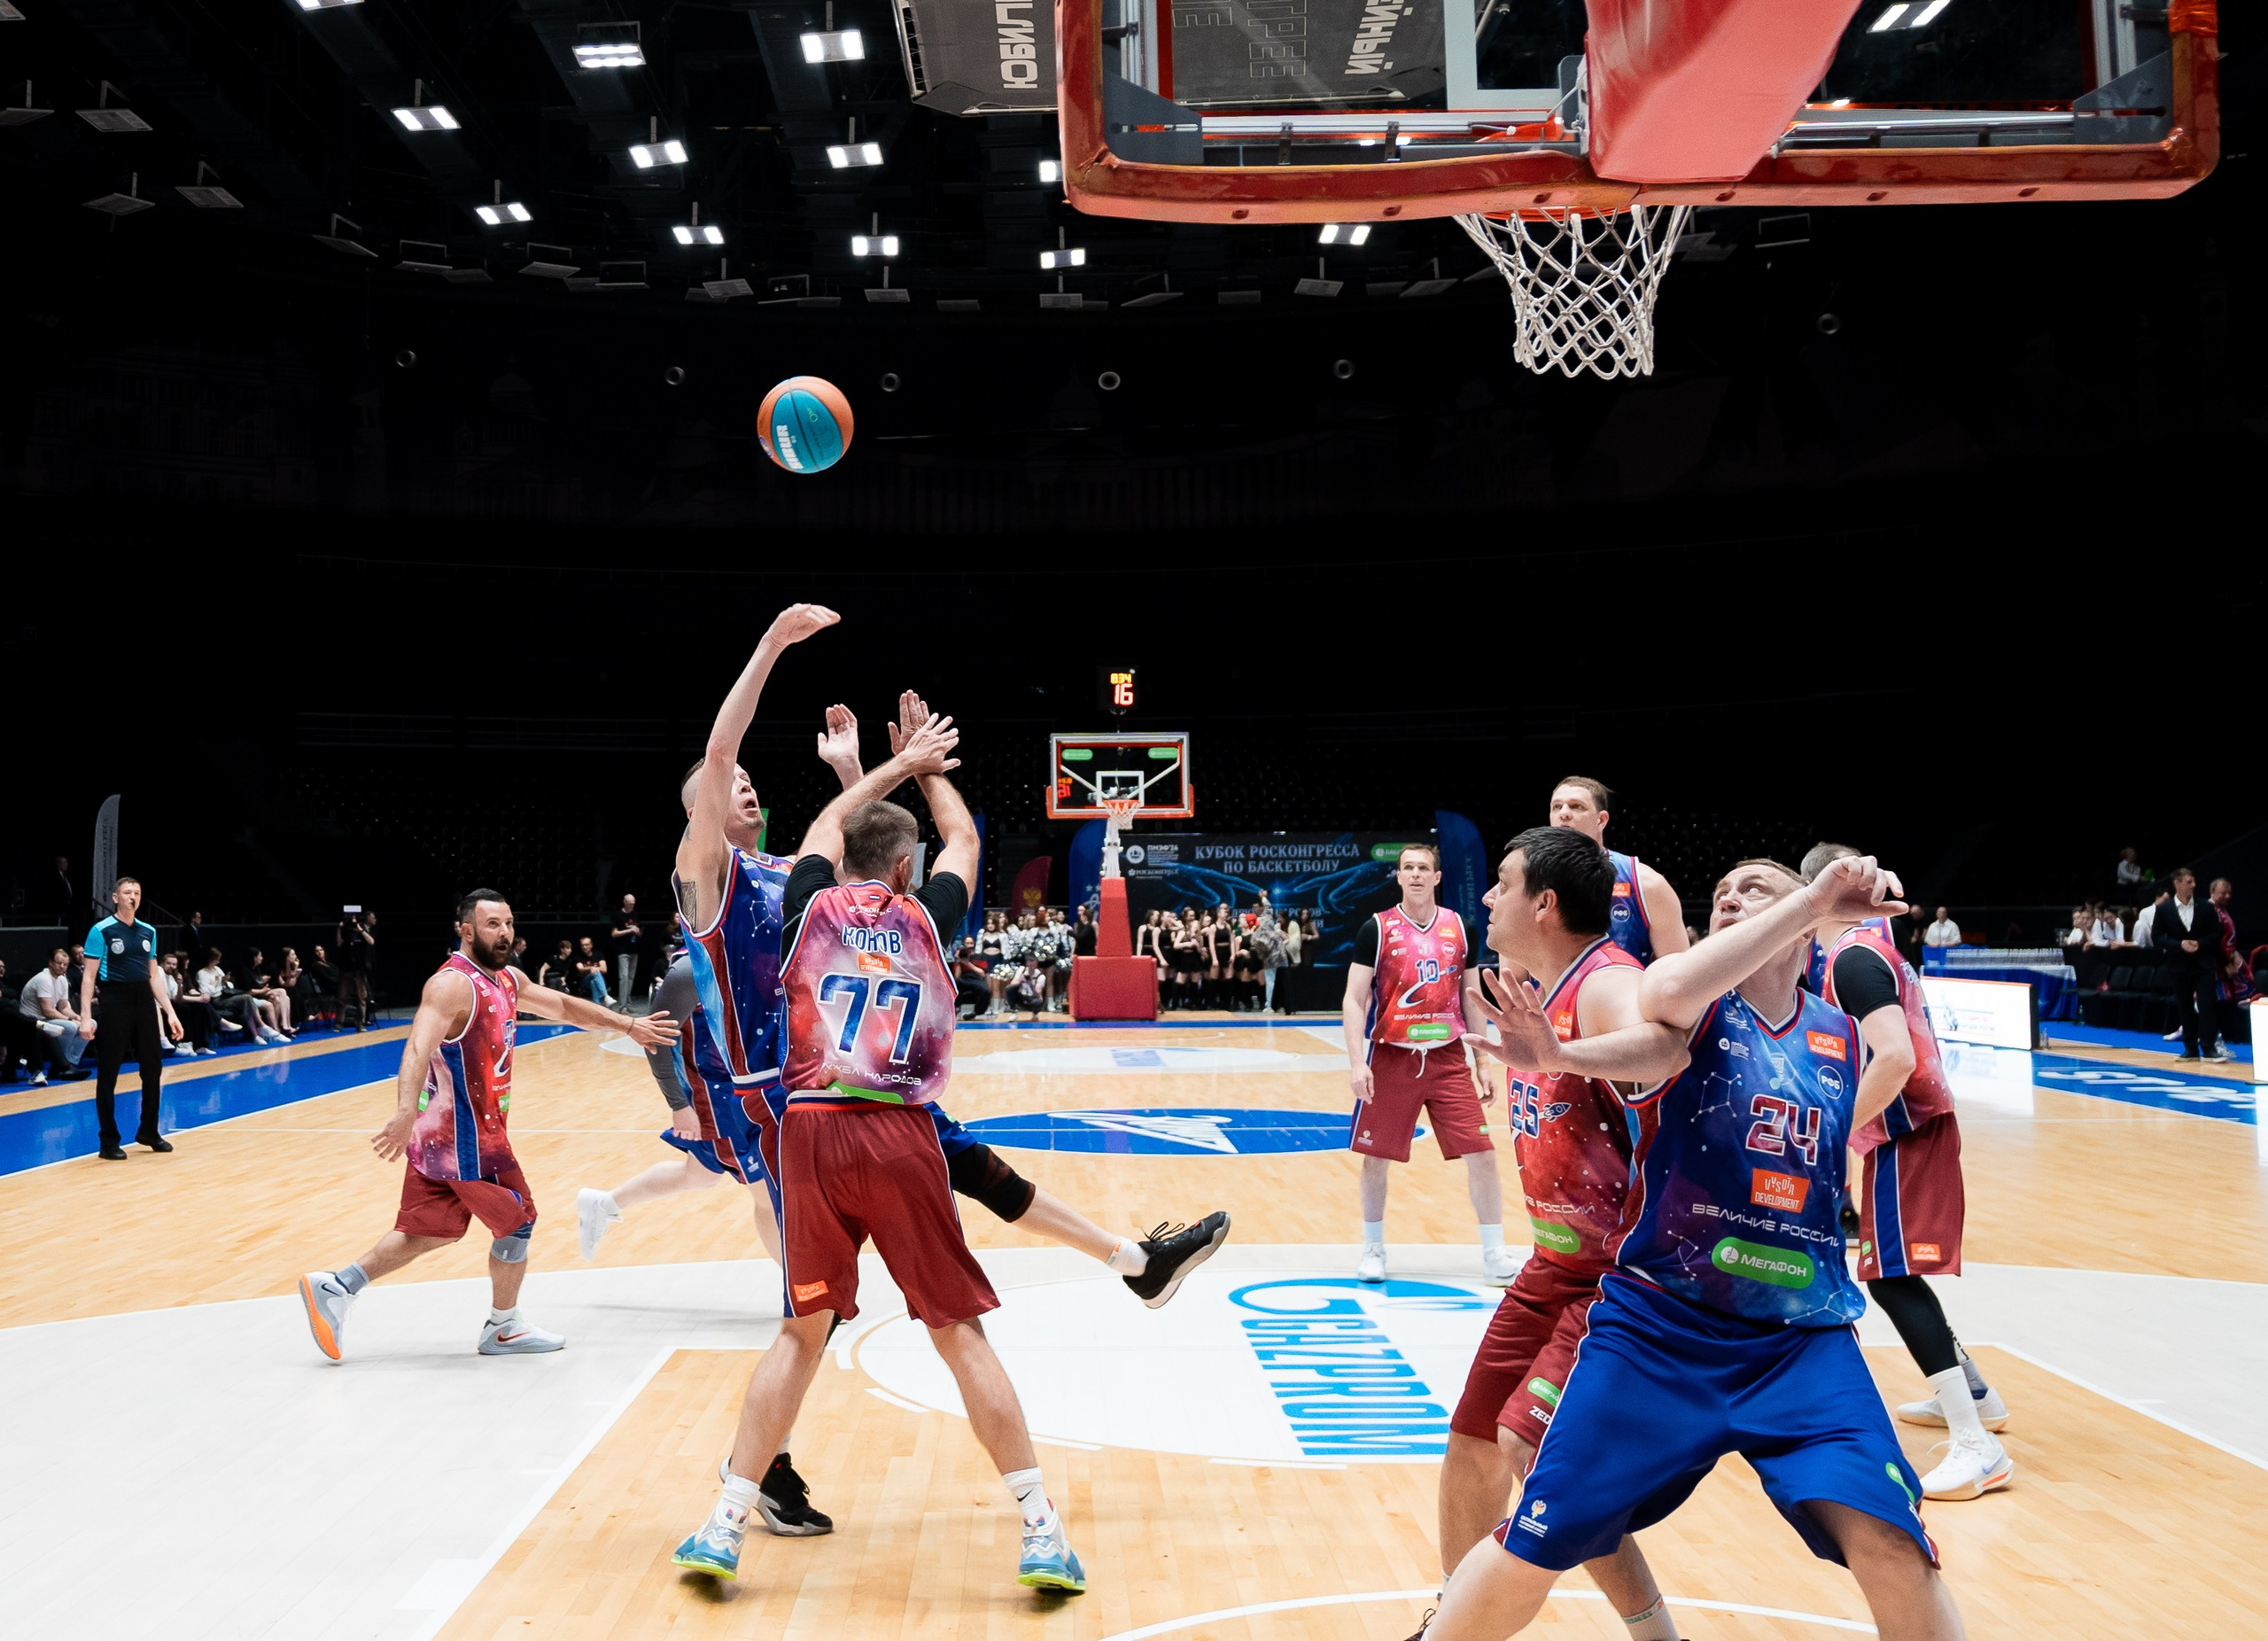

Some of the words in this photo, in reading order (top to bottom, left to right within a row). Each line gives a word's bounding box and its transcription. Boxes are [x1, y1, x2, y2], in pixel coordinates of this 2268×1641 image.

[996, 0, 1038, 89] ЮБИЛ
[1114, 683, 1134, 706] 16
[1195, 845, 1246, 859] КУБОК
[1250, 844, 1361, 859] РОСКОНГРЕССА
[1223, 861, 1244, 873] ПО
[1248, 859, 1340, 874] БАСКЕТБОЛУ
[1415, 959, 1440, 983] 10
[818, 972, 923, 1064] 77
[1821, 1075, 1841, 1090] РФБ
[1510, 1077, 1541, 1139] 25
[1745, 1093, 1821, 1166] 24
[1754, 1191, 1800, 1209] DEVELOPMENT
[1692, 1202, 1776, 1232] ВЕЛИЧИЕ
[1240, 1318, 1453, 1456] GAZPROM
